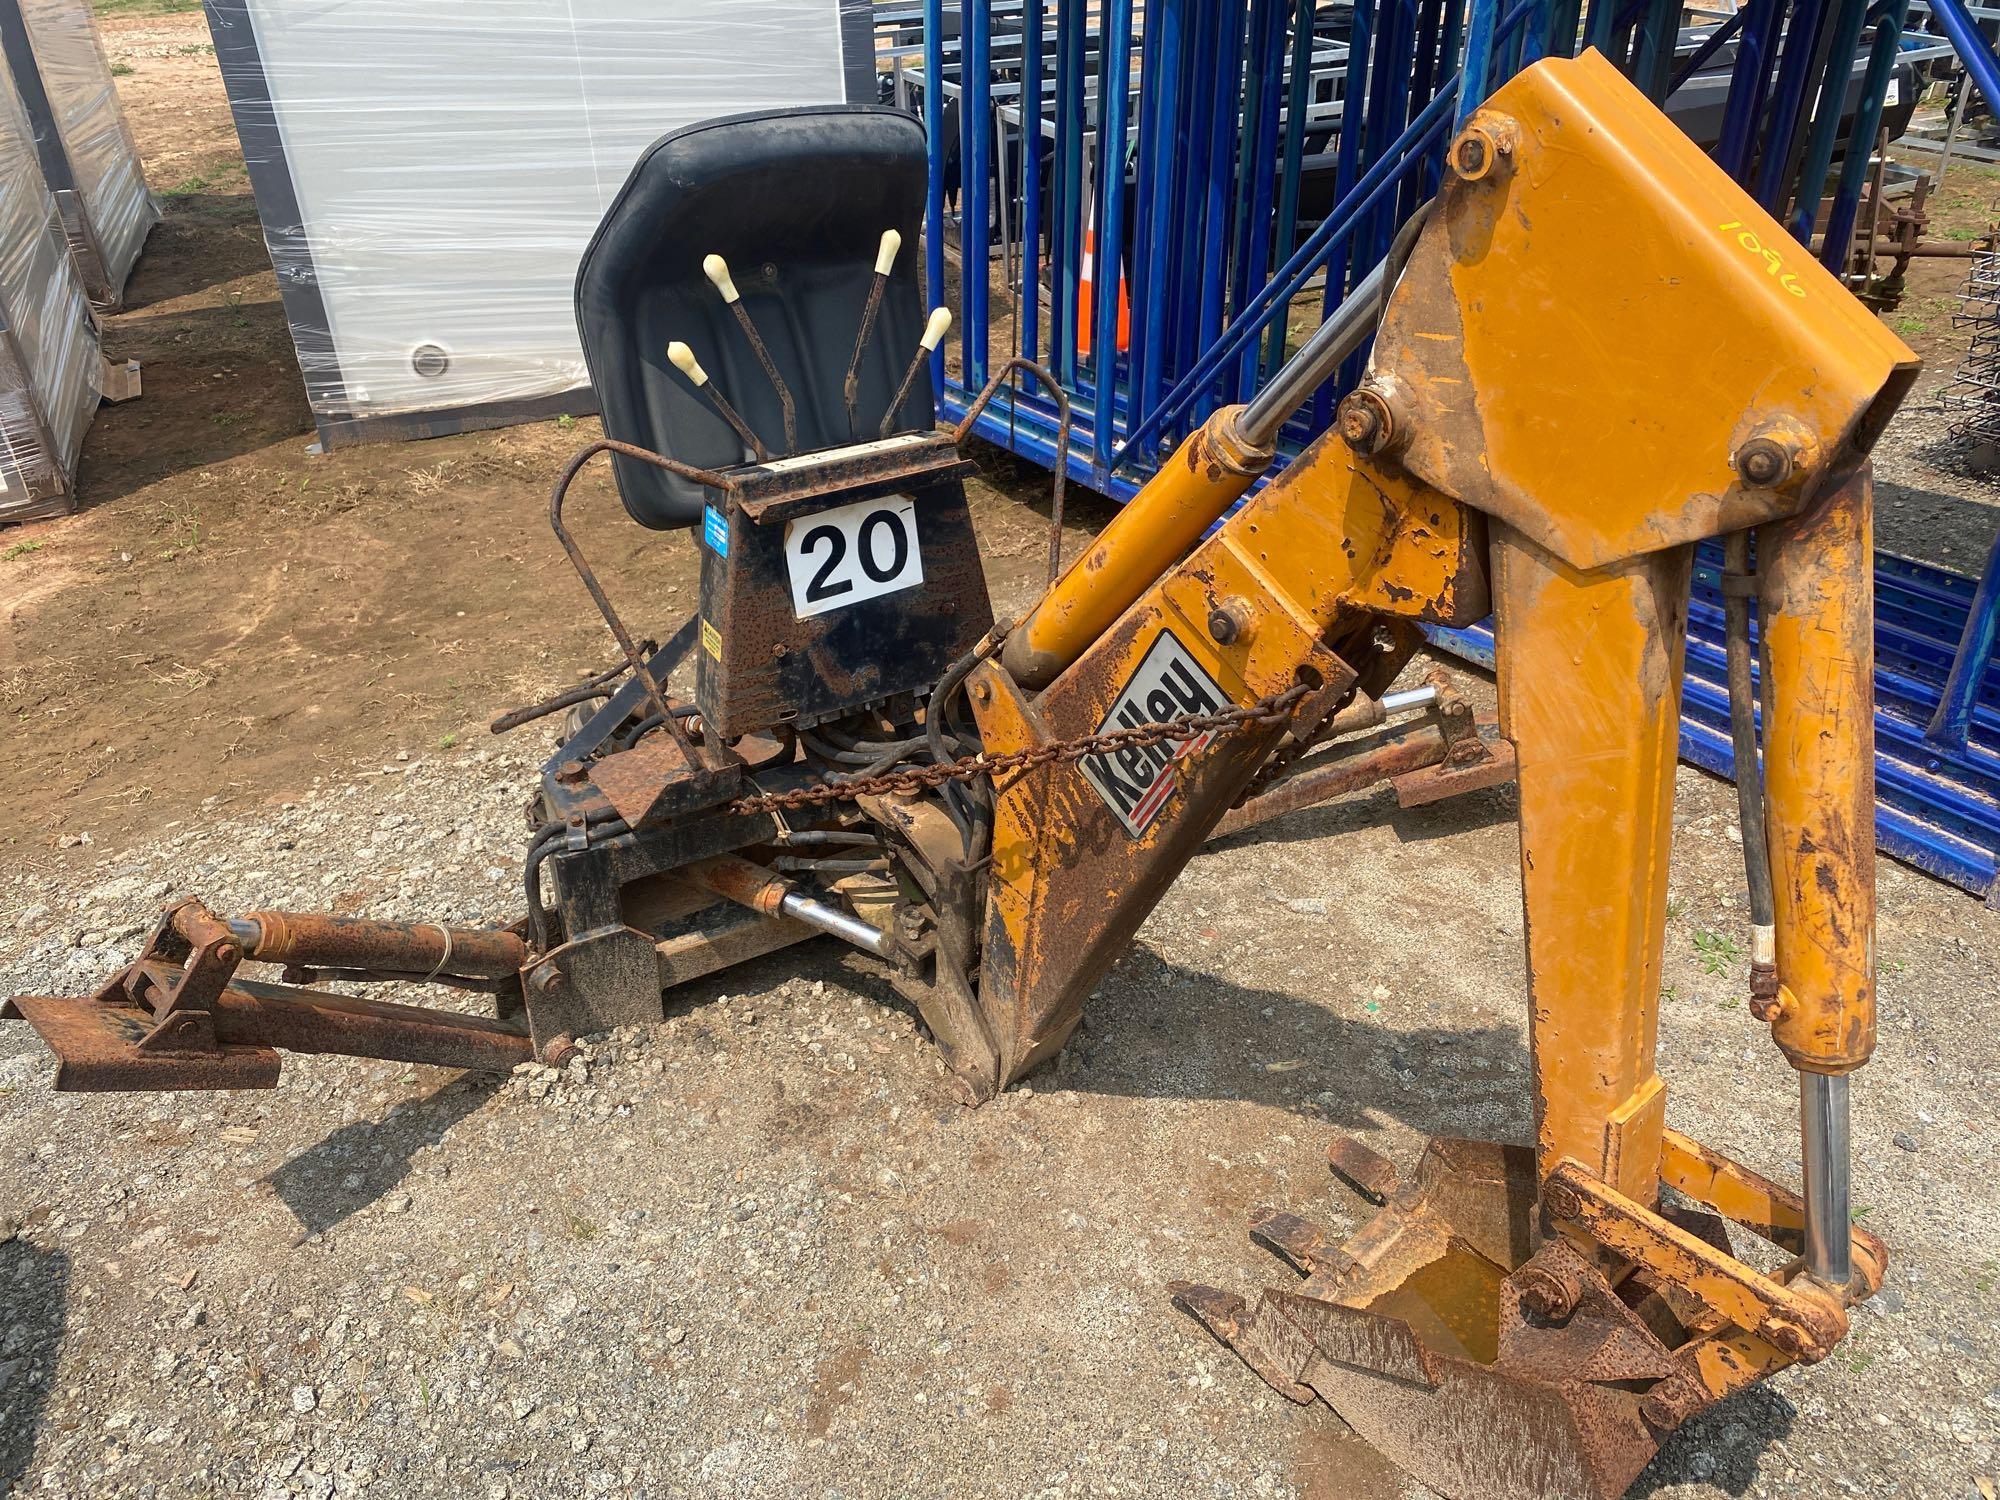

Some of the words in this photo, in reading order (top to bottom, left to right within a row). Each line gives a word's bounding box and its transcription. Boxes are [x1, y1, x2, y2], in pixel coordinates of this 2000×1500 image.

[1718, 221, 1807, 298] 1096
[800, 509, 908, 604] 20
[1084, 656, 1220, 816] Kelley
